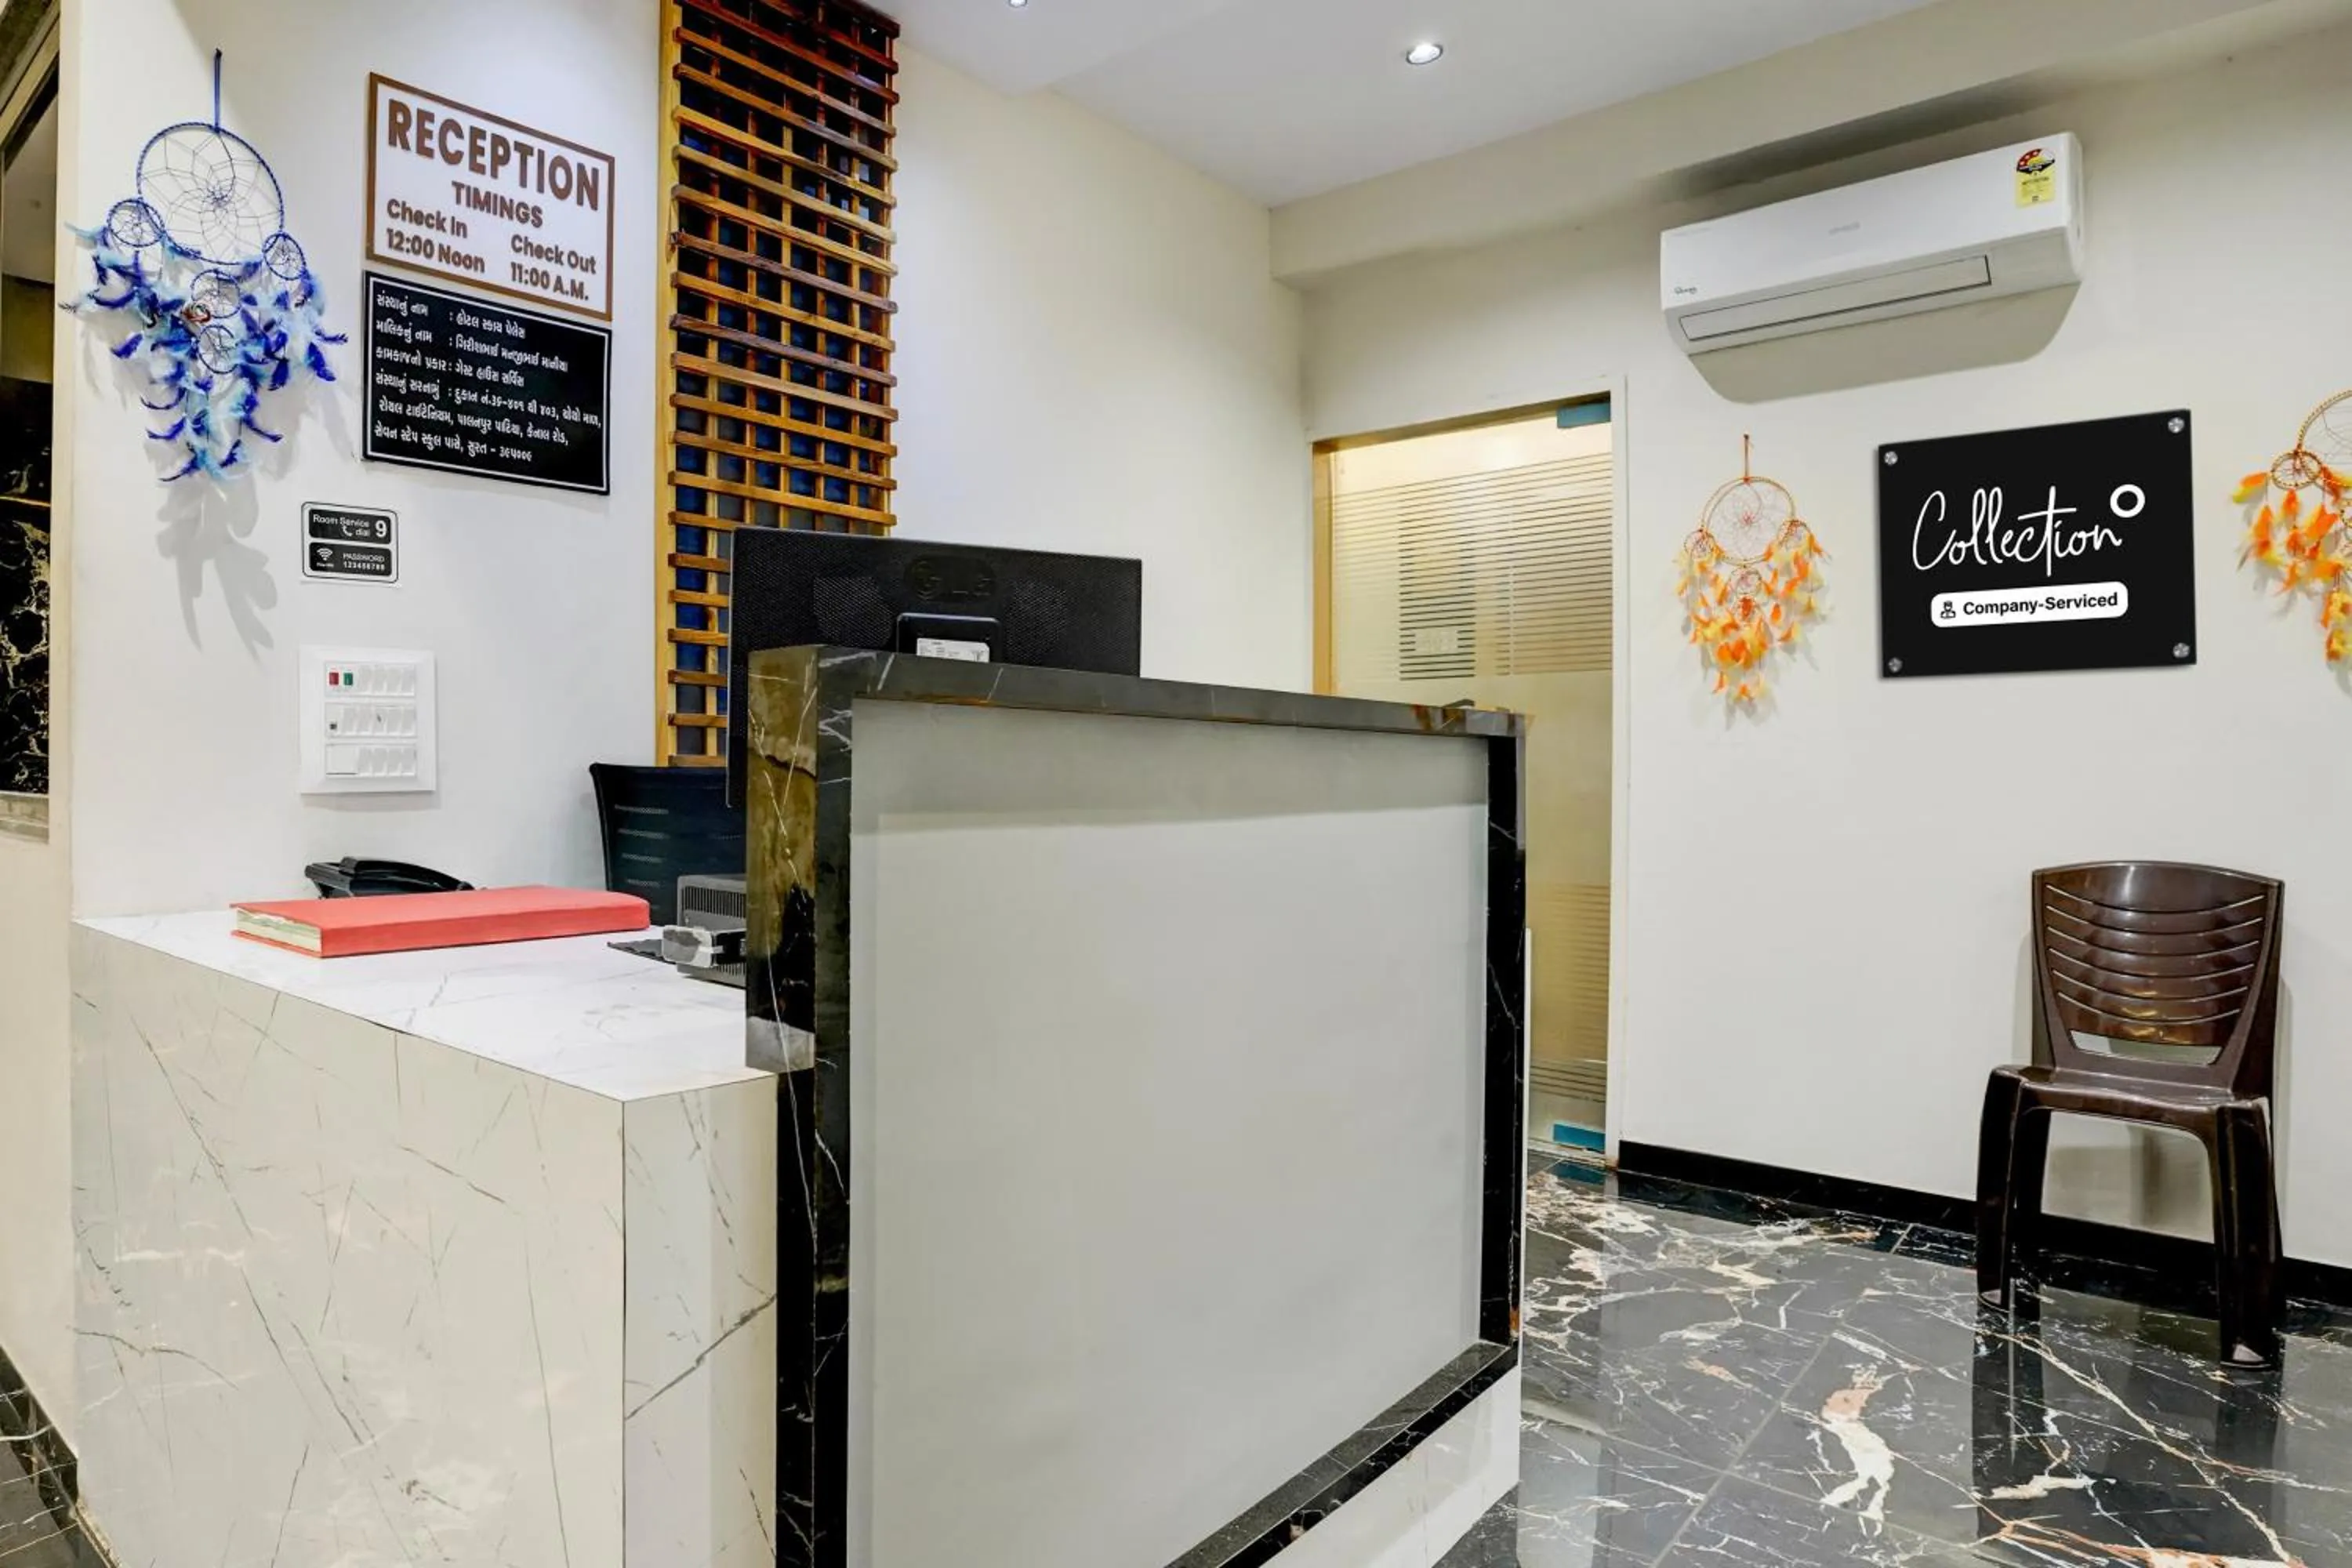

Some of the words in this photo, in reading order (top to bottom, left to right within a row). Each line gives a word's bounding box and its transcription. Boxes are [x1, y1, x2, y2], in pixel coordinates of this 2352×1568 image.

[388, 98, 599, 211] RECEPTION
[387, 199, 446, 232] Check
[452, 216, 467, 238] In
[452, 180, 543, 228] TIMINGS
[387, 227, 435, 259] 12:00
[438, 243, 485, 273] Noon
[511, 234, 564, 265] Check
[568, 250, 596, 274] Out
[510, 262, 549, 289] 11:00
[553, 275, 589, 300] A.M.
[410, 303, 428, 316] નામ
[416, 330, 432, 343] નામ
[314, 514, 338, 524] Room
[339, 517, 369, 528] Service
[376, 520, 387, 537] 9
[1913, 485, 2122, 577] Collection
[1962, 591, 2118, 617] Company-Serviced
